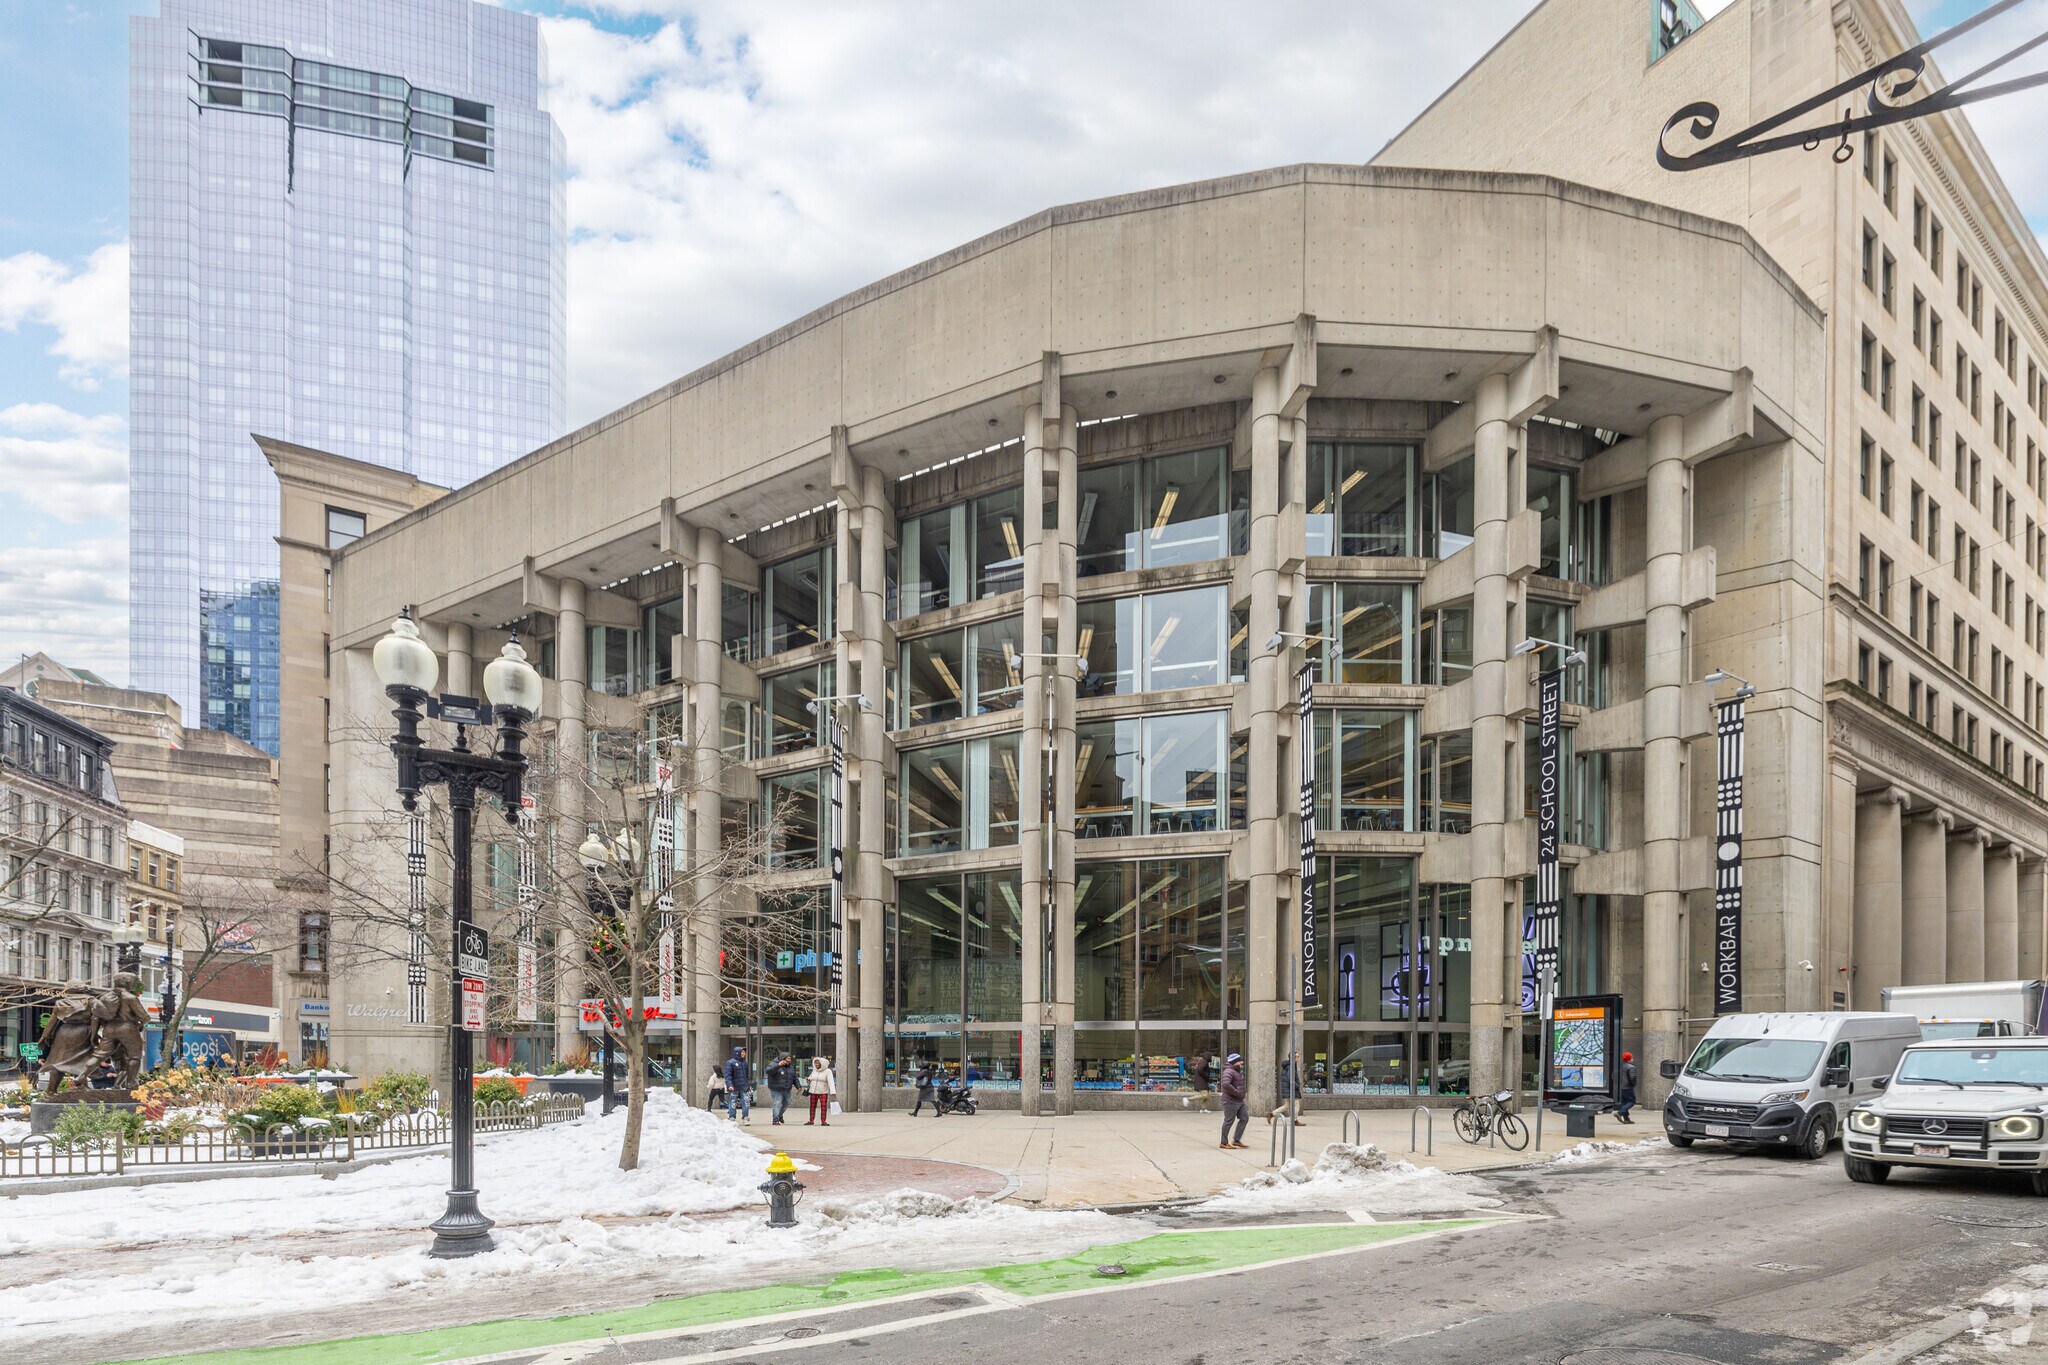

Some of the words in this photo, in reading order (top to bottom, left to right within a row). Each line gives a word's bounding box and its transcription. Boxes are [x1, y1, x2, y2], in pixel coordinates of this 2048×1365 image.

[1542, 681, 1558, 747] STREET
[1870, 740, 1885, 763] THE
[1888, 749, 1920, 780] BOSTON
[1923, 768, 1939, 791] FIVE
[1941, 779, 1964, 804] CENTS
[1541, 749, 1556, 831] SCHOOL
[1541, 835, 1555, 857] 24
[1303, 885, 1315, 996] PANORAMA
[461, 956, 473, 971] BIKE
[474, 960, 487, 975] LANE
[1719, 914, 1737, 1005] WORKBAR
[464, 981, 472, 990] TOW
[473, 982, 483, 991] ZONE
[346, 1003, 432, 1021] Walgree
[463, 1000, 483, 1009] STOPPING
[188, 1014, 213, 1025] verizon
[182, 1039, 219, 1058] pepsi
